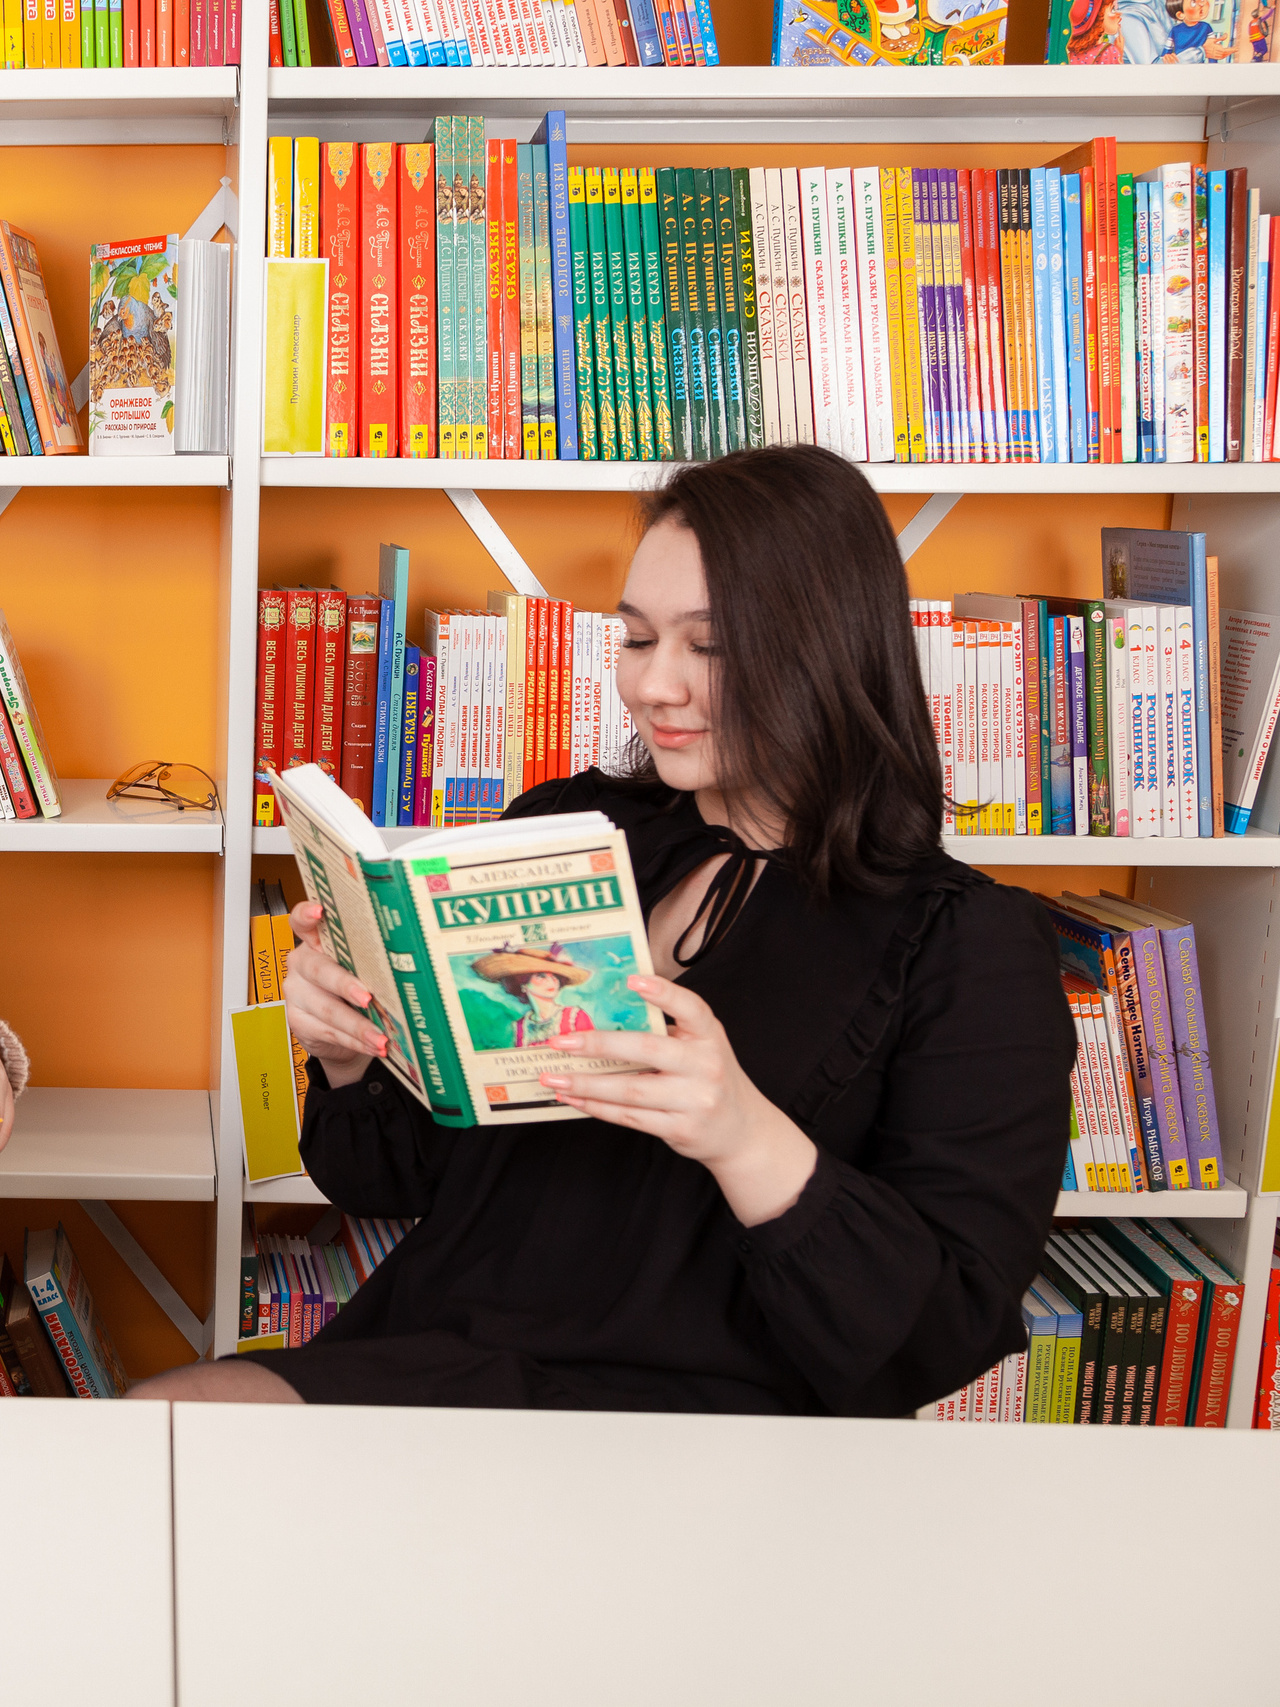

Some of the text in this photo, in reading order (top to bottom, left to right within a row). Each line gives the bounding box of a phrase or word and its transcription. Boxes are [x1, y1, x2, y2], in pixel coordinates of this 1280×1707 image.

[553, 162, 569, 297] ЗОЛОТЫЕ СКАЗКИ
[1035, 179, 1045, 227] ПУШКИН
[143, 241, 163, 253] ЧТЕНИЕ
[812, 207, 822, 256] ПУШКИН
[1139, 210, 1148, 264] СКАЗКИ
[575, 251, 587, 305] СКАЗКИ
[721, 242, 736, 313] Пушкин
[736, 230, 756, 319] СКАЗКИ
[791, 293, 806, 362] СКАЗКИ
[1196, 254, 1208, 387] ВСЕ СКАЗКИ ПУШКИНА
[290, 314, 301, 404] Пушкин Александр
[1140, 275, 1152, 422] АЛЕКСАНДР ПУШКИН
[104, 423, 157, 431] РАССКАЗЫ ПРИРОДЕ
[109, 398, 152, 408] ОРАНЖЕВОЕ
[111, 410, 151, 421] ГОРЛЫШКО
[1179, 639, 1192, 650] 4
[262, 640, 277, 750] ВЕСЬ ПУШКИН ДЛЯ ДЕТЕЙ
[1055, 628, 1066, 744] СТРАЖИ БЕЛЫХ НОЧЕЙ
[1074, 666, 1085, 744] ДЕРЗКОЕ НАПАДЕНИЕ
[536, 671, 546, 762] РУСЛАН ЛЮДМИЛА
[956, 683, 965, 763] РАССКАЗЫ ПРИРОДЕ
[403, 750, 413, 788] Пушкин
[460, 733, 468, 768] ЛЮБИМЫЕ
[469, 861, 573, 885] АЛЕКСАНДР
[438, 879, 616, 926] КУПРИН
[1178, 937, 1211, 1143] Самая большая книга сказок
[260, 1072, 268, 1089] Рой
[293, 1301, 303, 1343] КАМЕНЬ
[1143, 1365, 1156, 1402] ПОЛЯНКА
